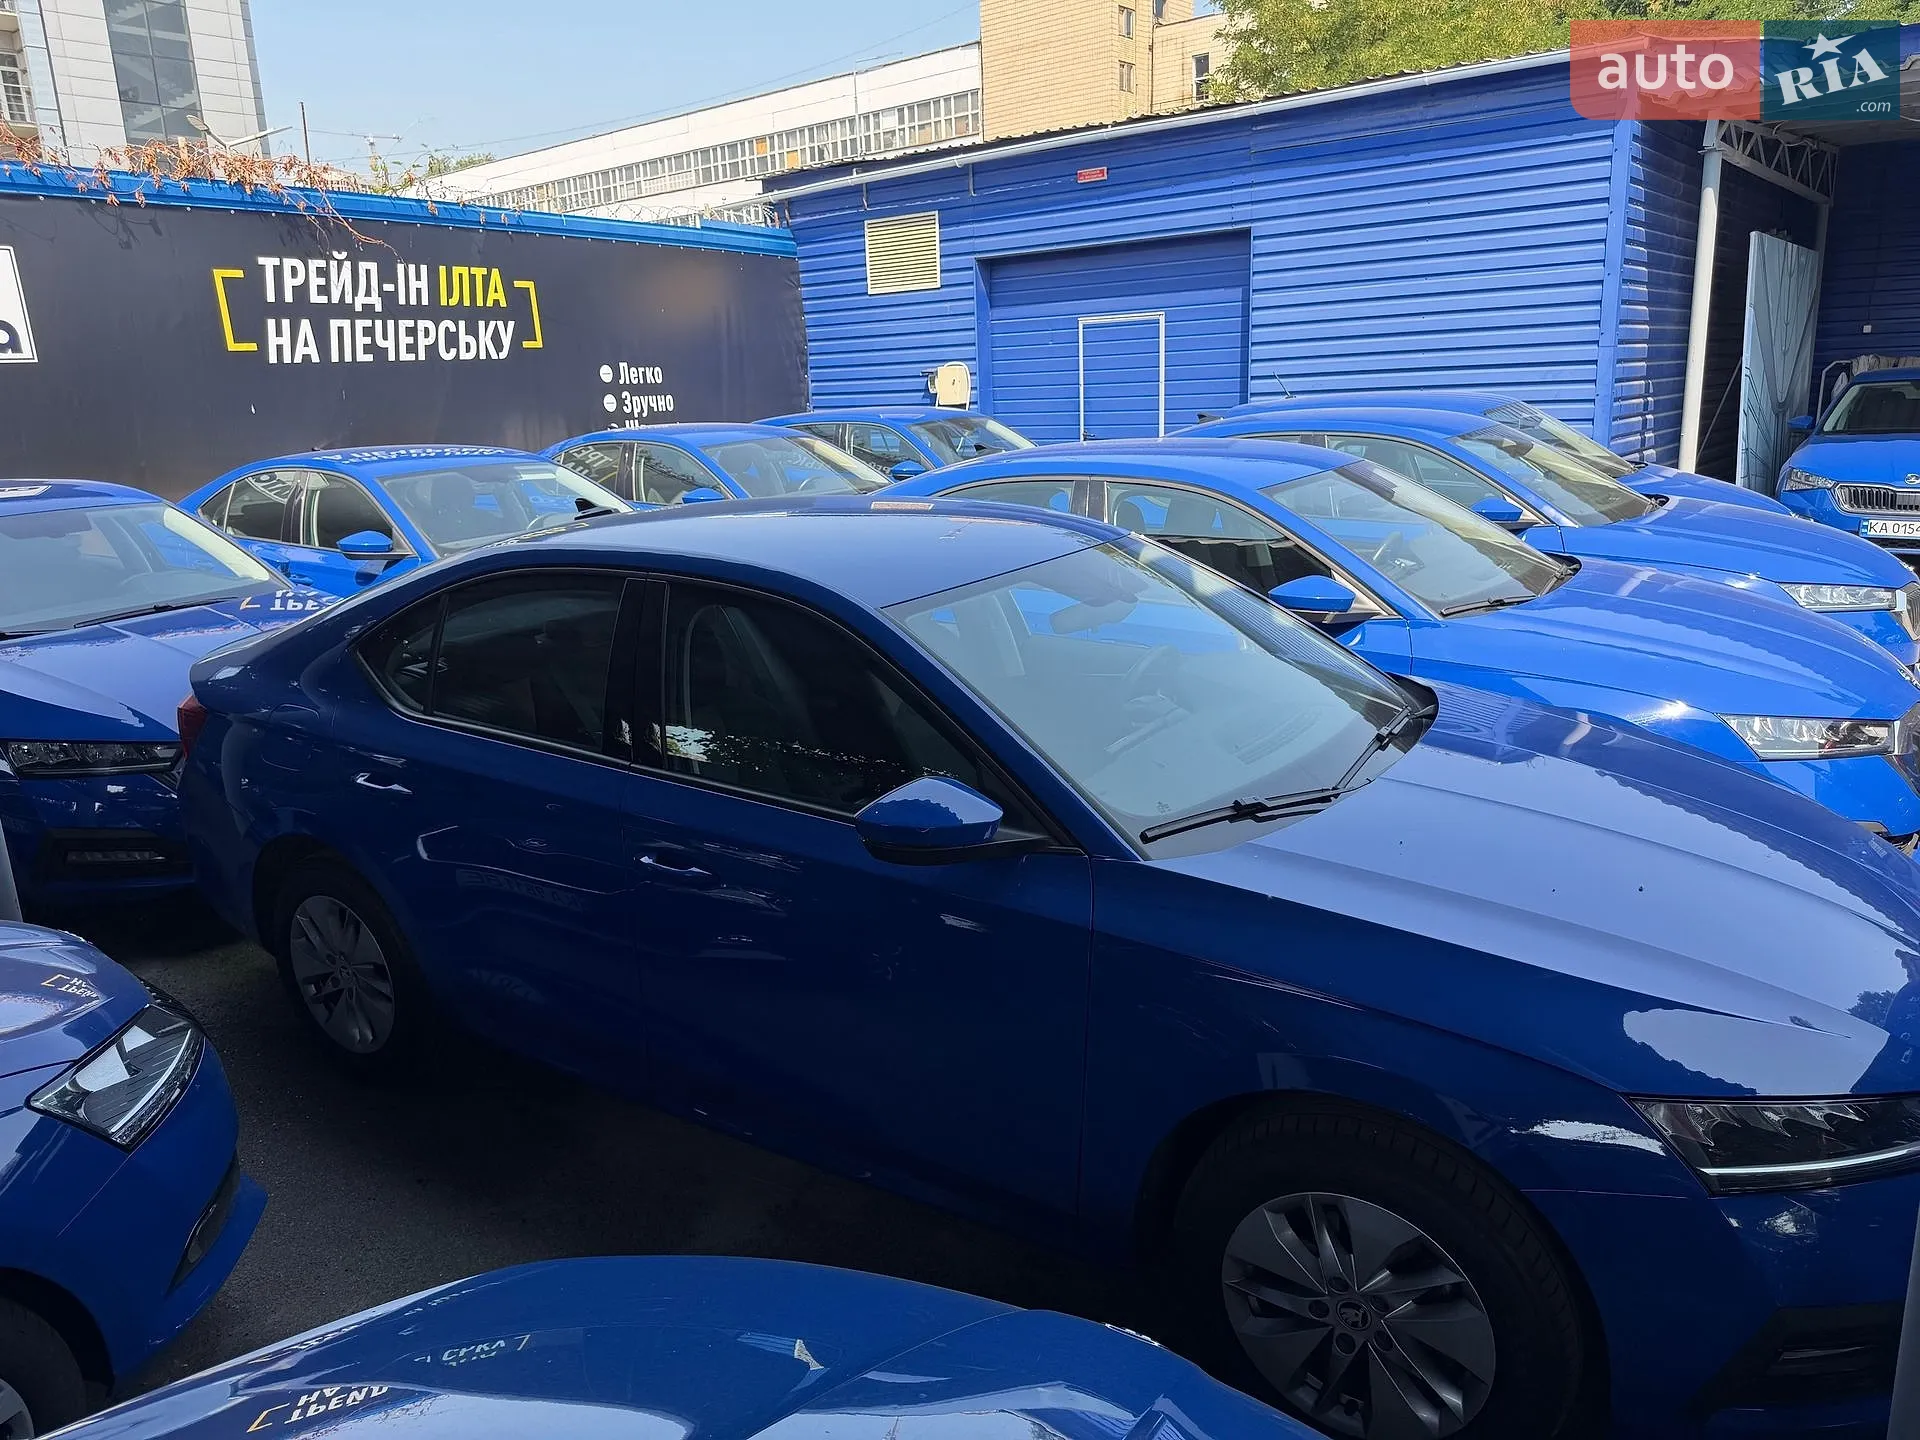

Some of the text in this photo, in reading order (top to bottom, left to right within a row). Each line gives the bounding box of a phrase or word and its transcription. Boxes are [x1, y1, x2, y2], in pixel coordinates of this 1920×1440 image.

[257, 250, 507, 312] ТРЕЙД-ІН ІЛТА
[266, 318, 516, 364] НА ПЕЧЕРСЬКУ
[618, 361, 663, 385] Легко
[621, 390, 675, 418] Зручно
[1868, 521, 1889, 534] KA
